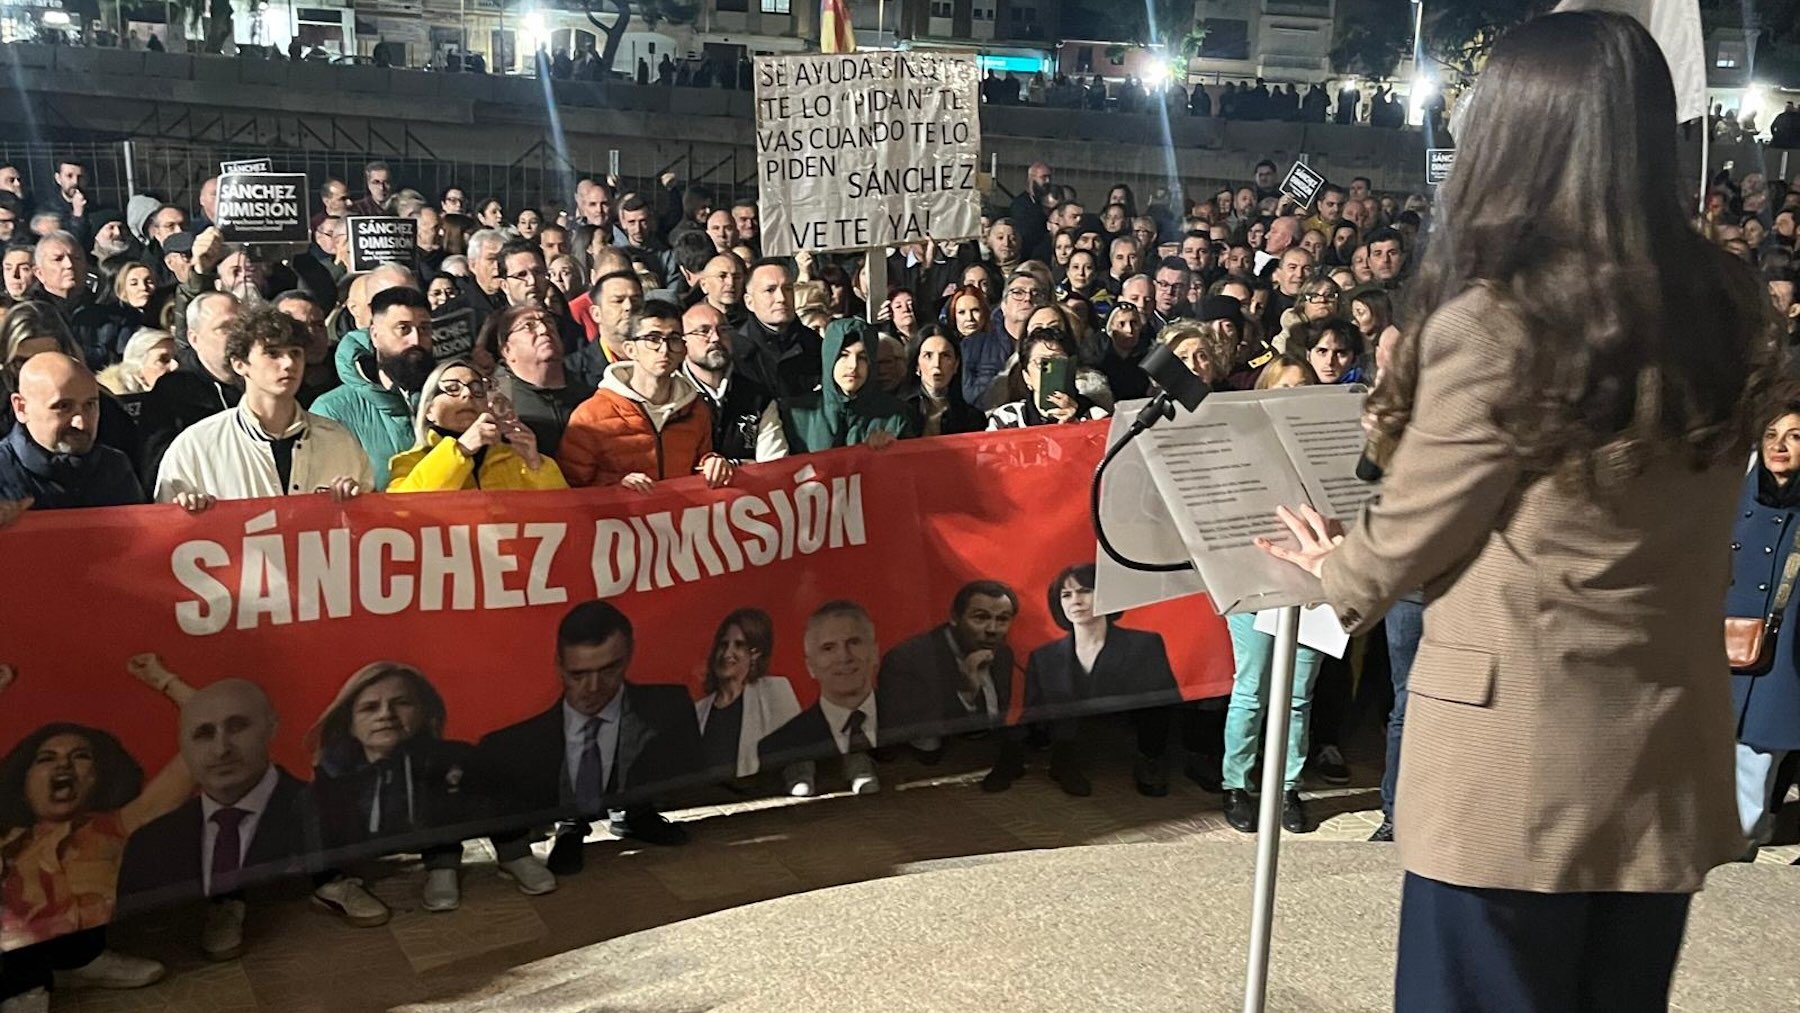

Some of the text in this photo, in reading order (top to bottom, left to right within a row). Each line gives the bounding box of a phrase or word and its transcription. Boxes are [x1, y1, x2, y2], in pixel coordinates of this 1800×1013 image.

[761, 63, 788, 87] SE
[795, 58, 875, 86] AYUDA
[881, 56, 917, 79] SIN
[762, 96, 791, 119] TE
[802, 95, 831, 118] LO
[757, 120, 969, 152] VAS CUANDO TE LO
[766, 156, 836, 182] PIDEN
[848, 163, 974, 199] SÁNCHEZ
[220, 180, 297, 199] SÁNCHEZ
[219, 198, 298, 217] DIMISIÓN
[358, 219, 413, 235] SÁNCHEZ
[888, 210, 931, 240] YA!
[171, 464, 867, 636] SÁNCHEZ DIMISIÓN
